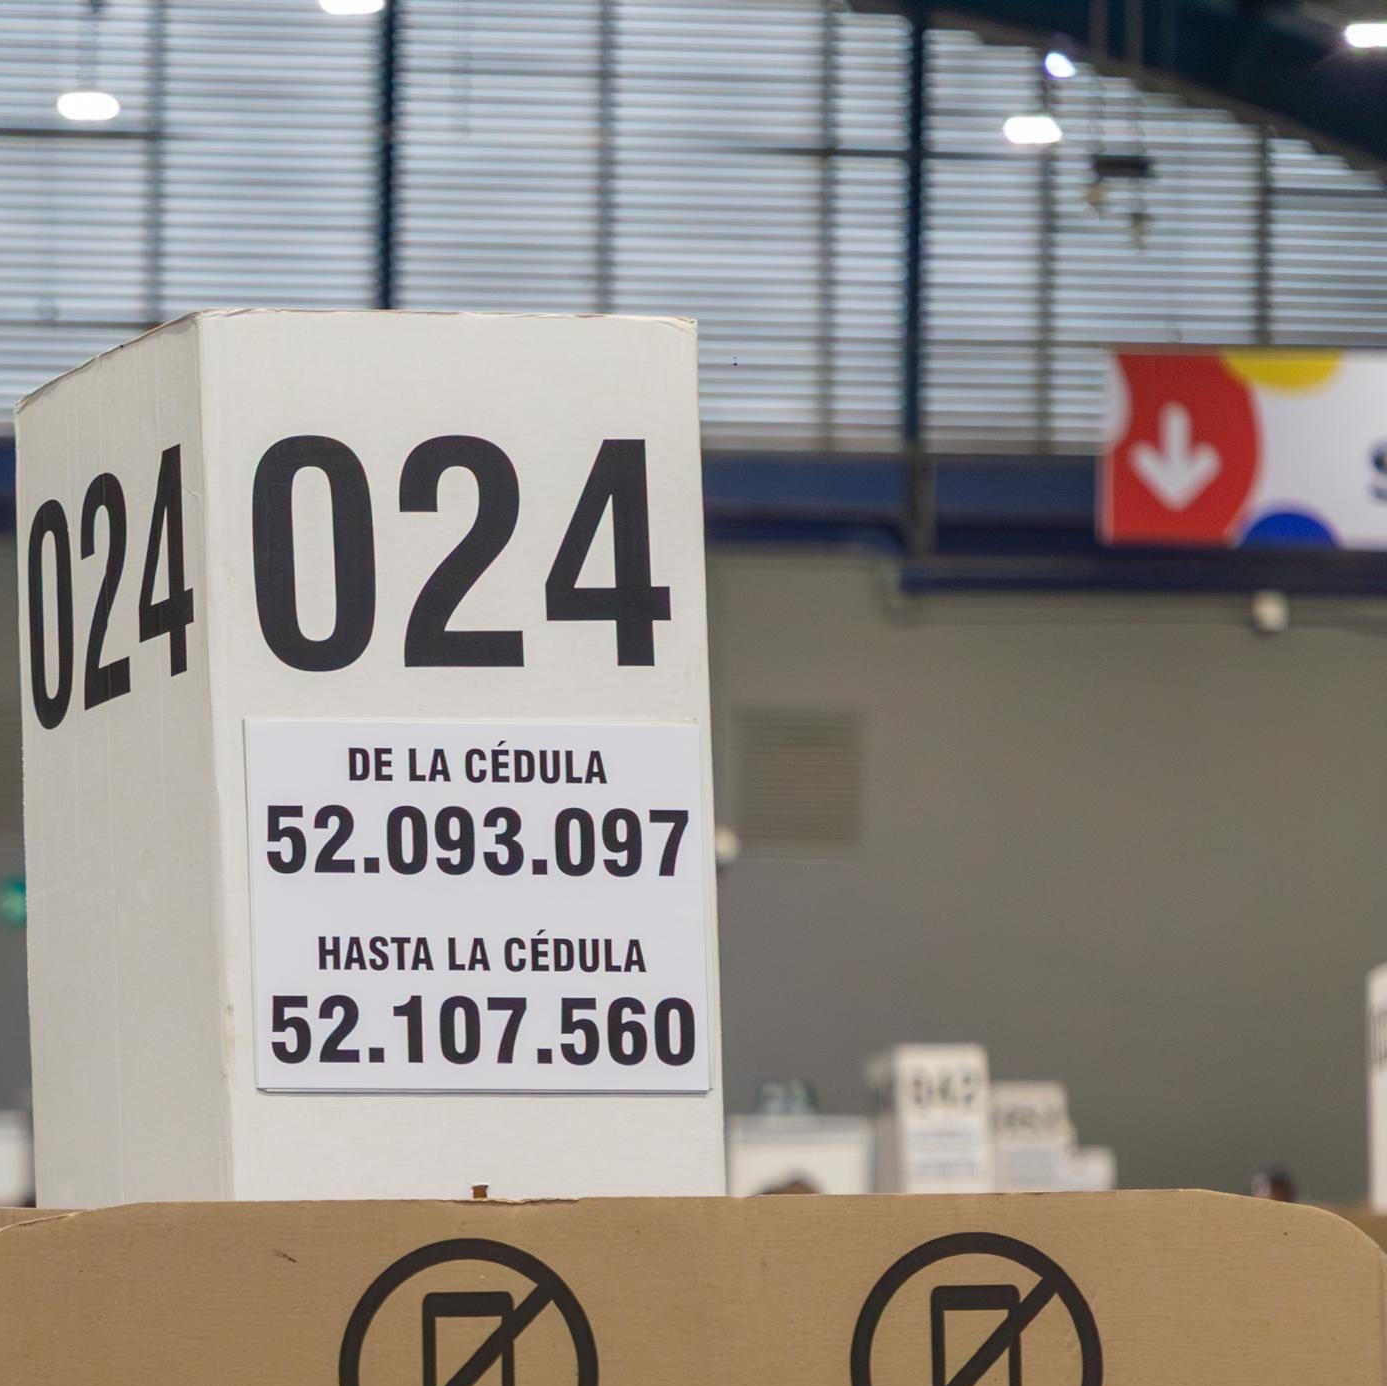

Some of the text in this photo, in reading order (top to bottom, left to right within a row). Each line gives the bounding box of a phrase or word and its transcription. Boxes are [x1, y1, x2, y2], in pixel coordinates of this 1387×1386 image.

[29, 444, 194, 729] 024
[252, 434, 672, 672] 024
[348, 740, 608, 785] DE LA CÉDULA
[265, 804, 690, 877] 52.093.097
[318, 929, 647, 973] HASTA LA CÉDULA
[271, 994, 697, 1068] 52.107.560
